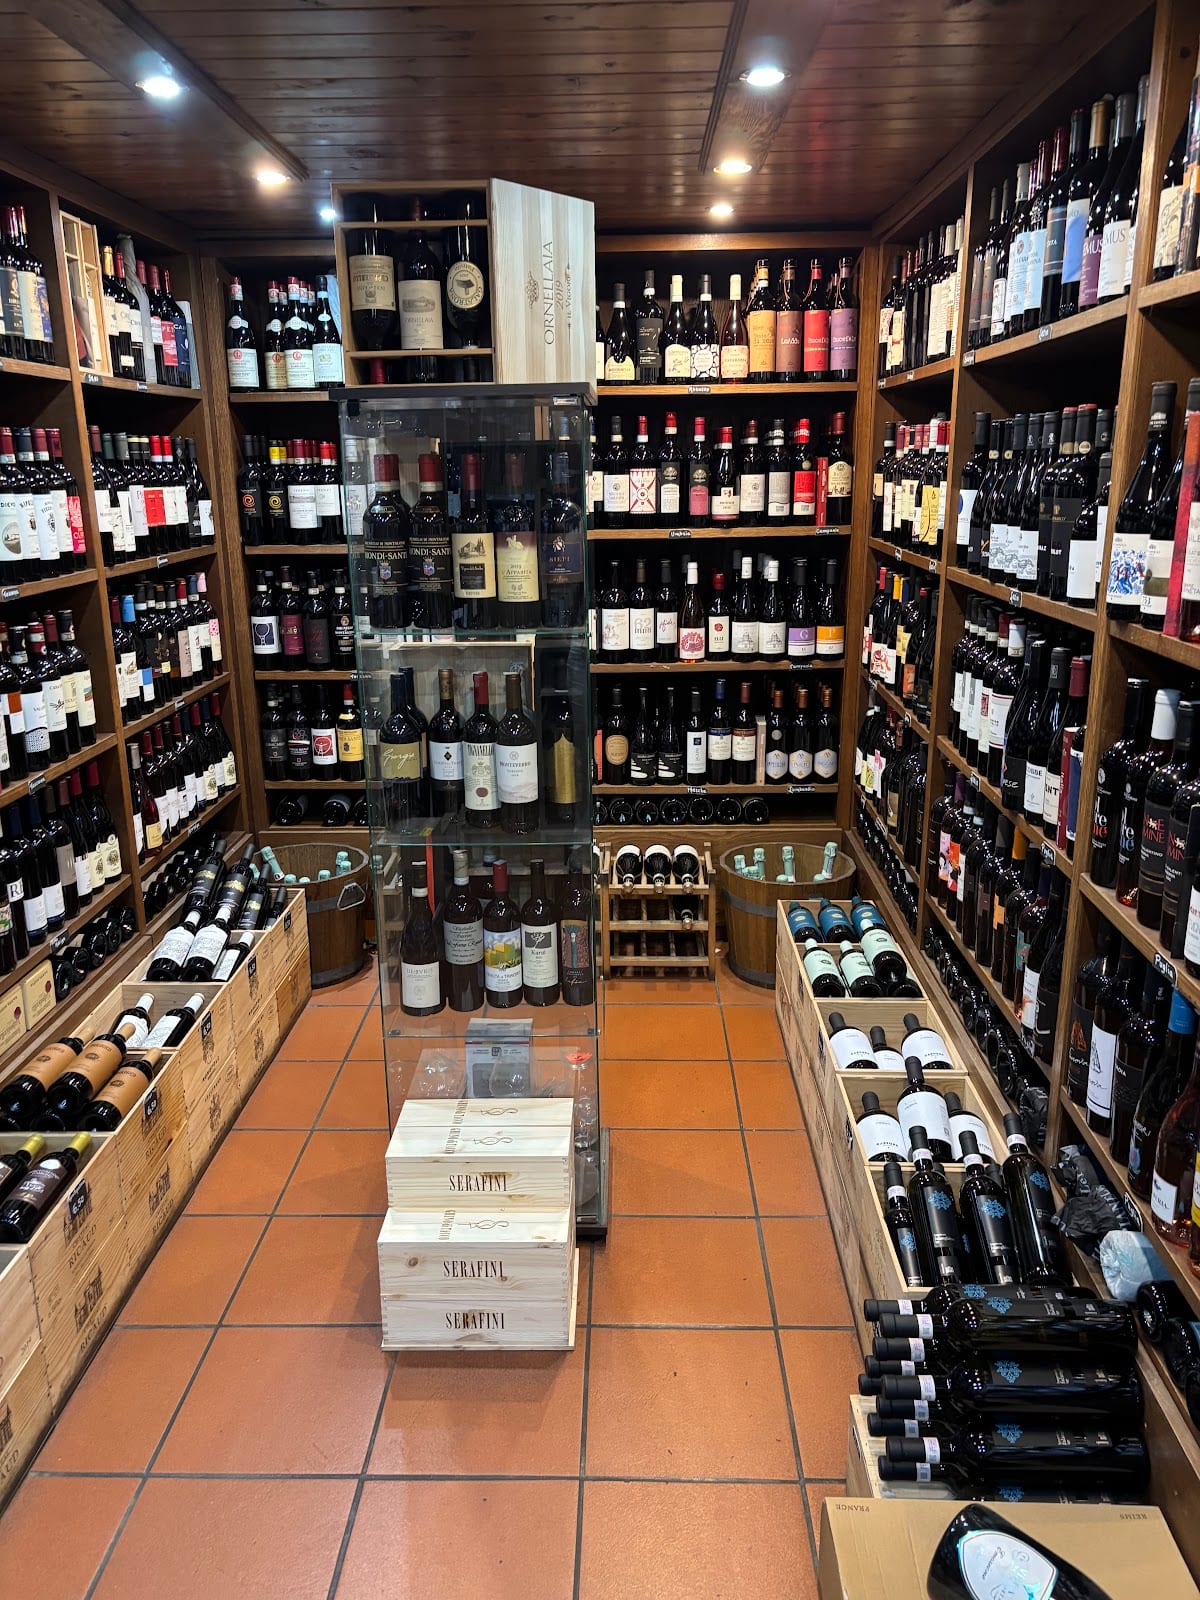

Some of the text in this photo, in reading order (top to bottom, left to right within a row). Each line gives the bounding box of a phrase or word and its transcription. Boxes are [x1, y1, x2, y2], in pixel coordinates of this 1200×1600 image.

[542, 240, 554, 345] ORNELLAIA
[554, 280, 564, 311] 2019
[1154, 953, 1174, 979] Puglia
[449, 1174, 508, 1192] SERAFINI
[443, 1260, 504, 1278] SERAFINI
[445, 1312, 505, 1330] SERAFINI
[836, 1503, 870, 1512] FRANCE
[1119, 1512, 1148, 1520] REIMS
